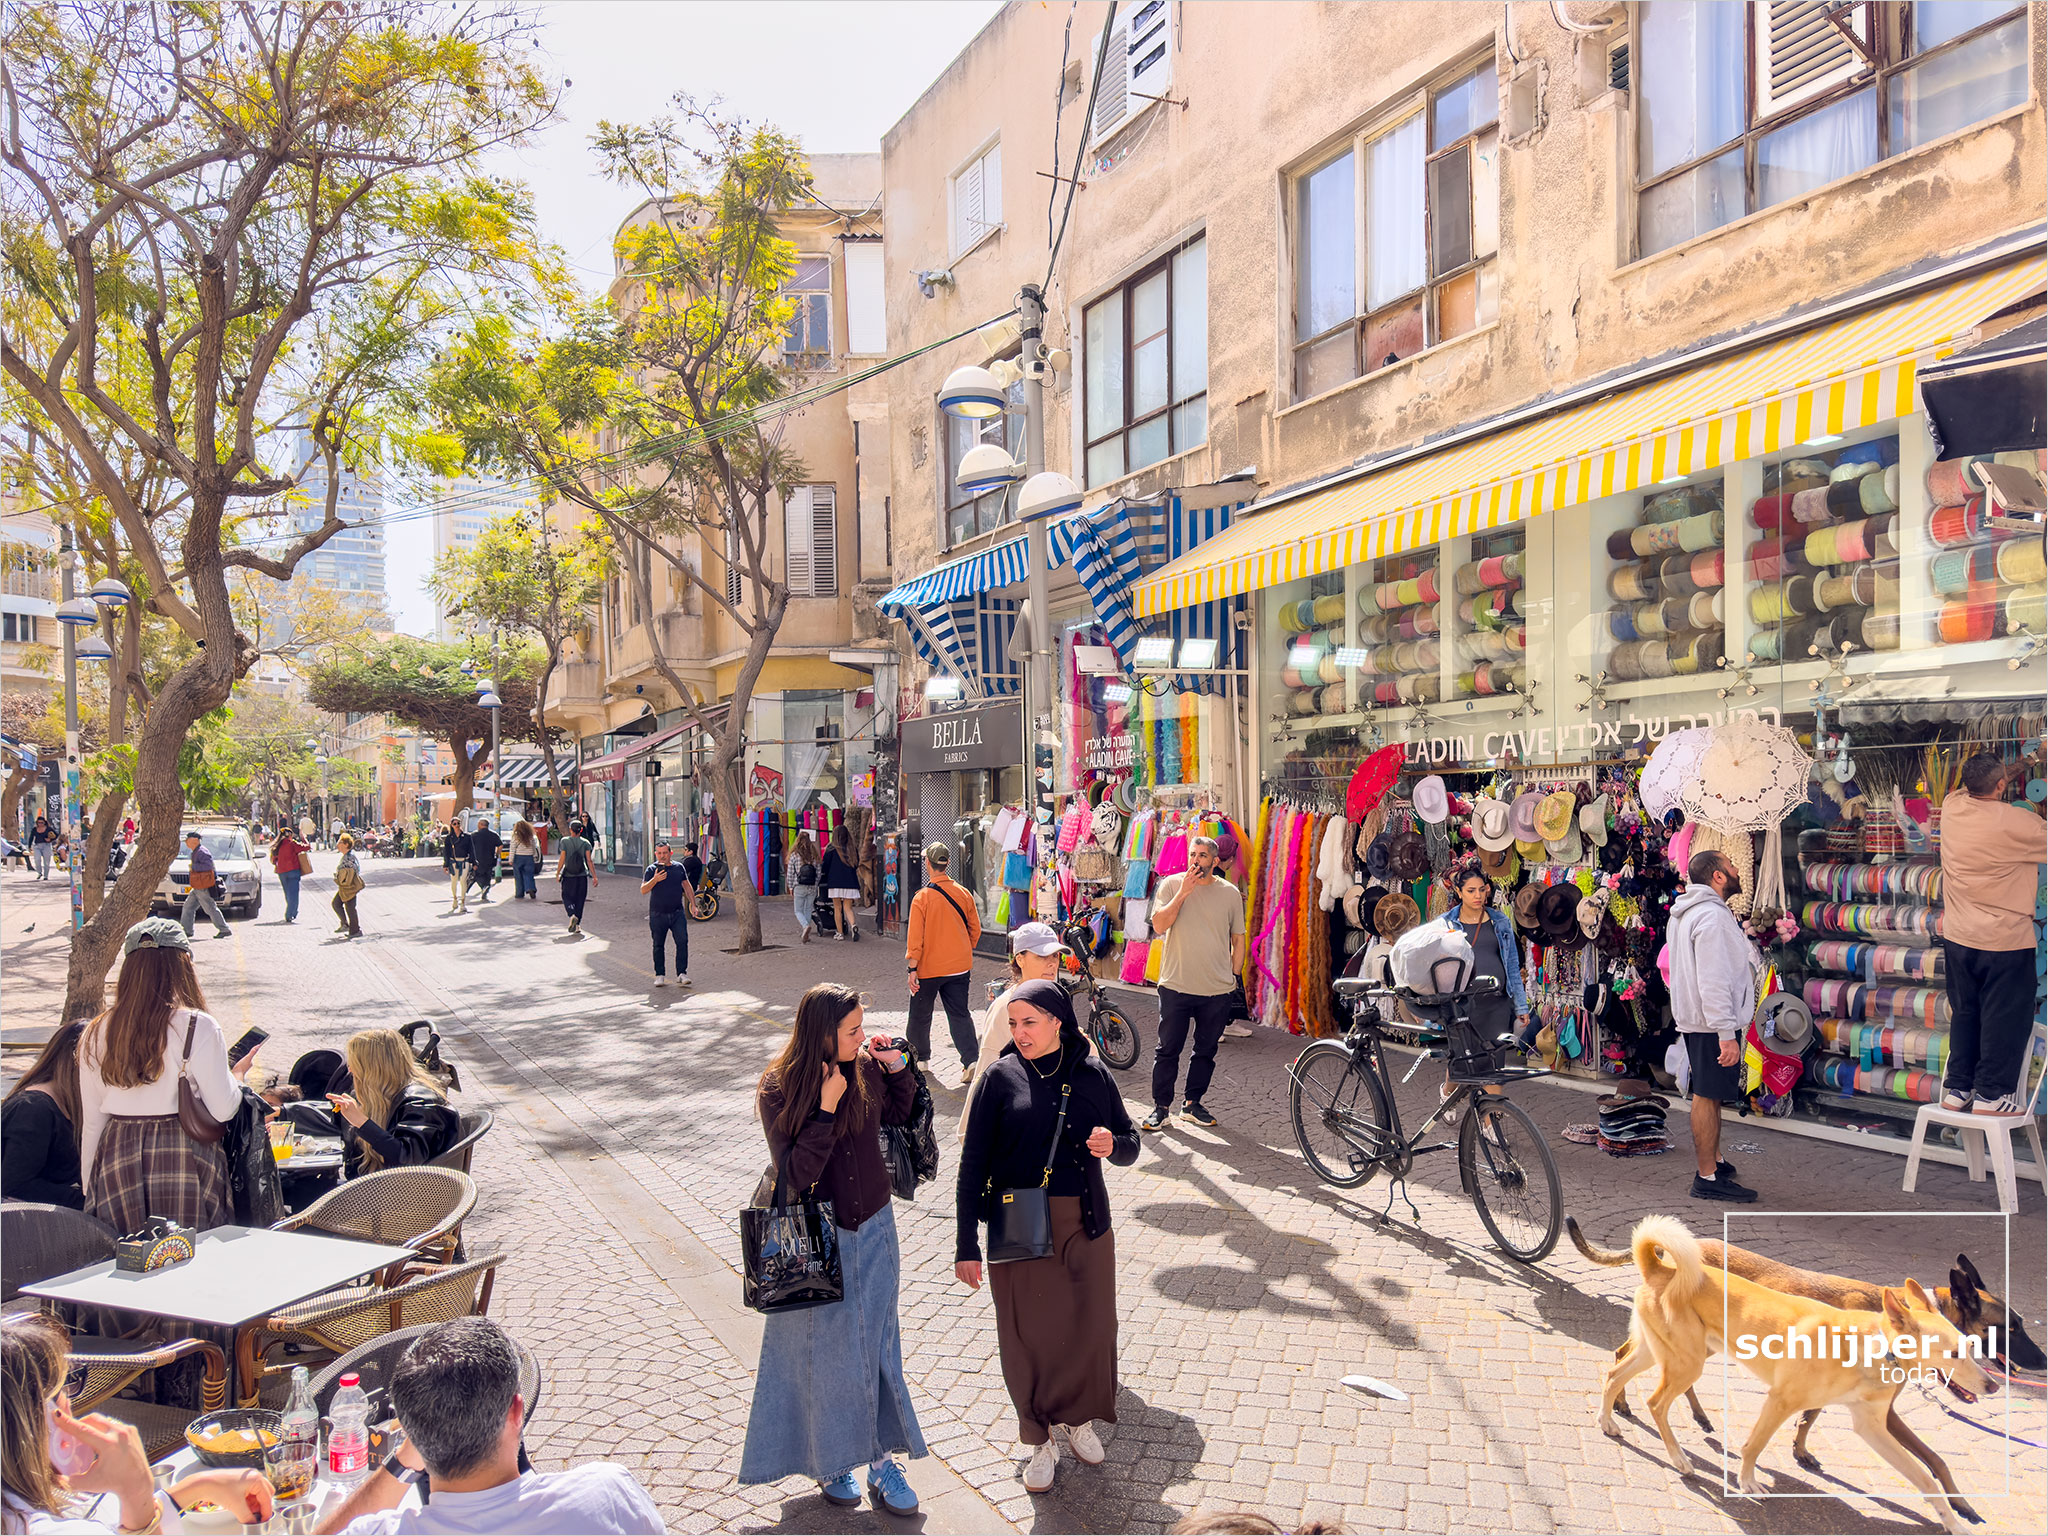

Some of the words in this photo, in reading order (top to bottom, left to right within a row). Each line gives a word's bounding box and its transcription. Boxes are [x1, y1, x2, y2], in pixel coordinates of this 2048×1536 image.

[932, 717, 983, 749] BELLA
[1557, 717, 1622, 756] אלדין
[1629, 713, 1670, 743] של
[944, 752, 968, 763] FABRICS
[1089, 751, 1113, 767] ALADIN
[1115, 749, 1133, 765] CAVE
[1391, 735, 1474, 764] LADIN
[1483, 727, 1552, 759] CAVE
